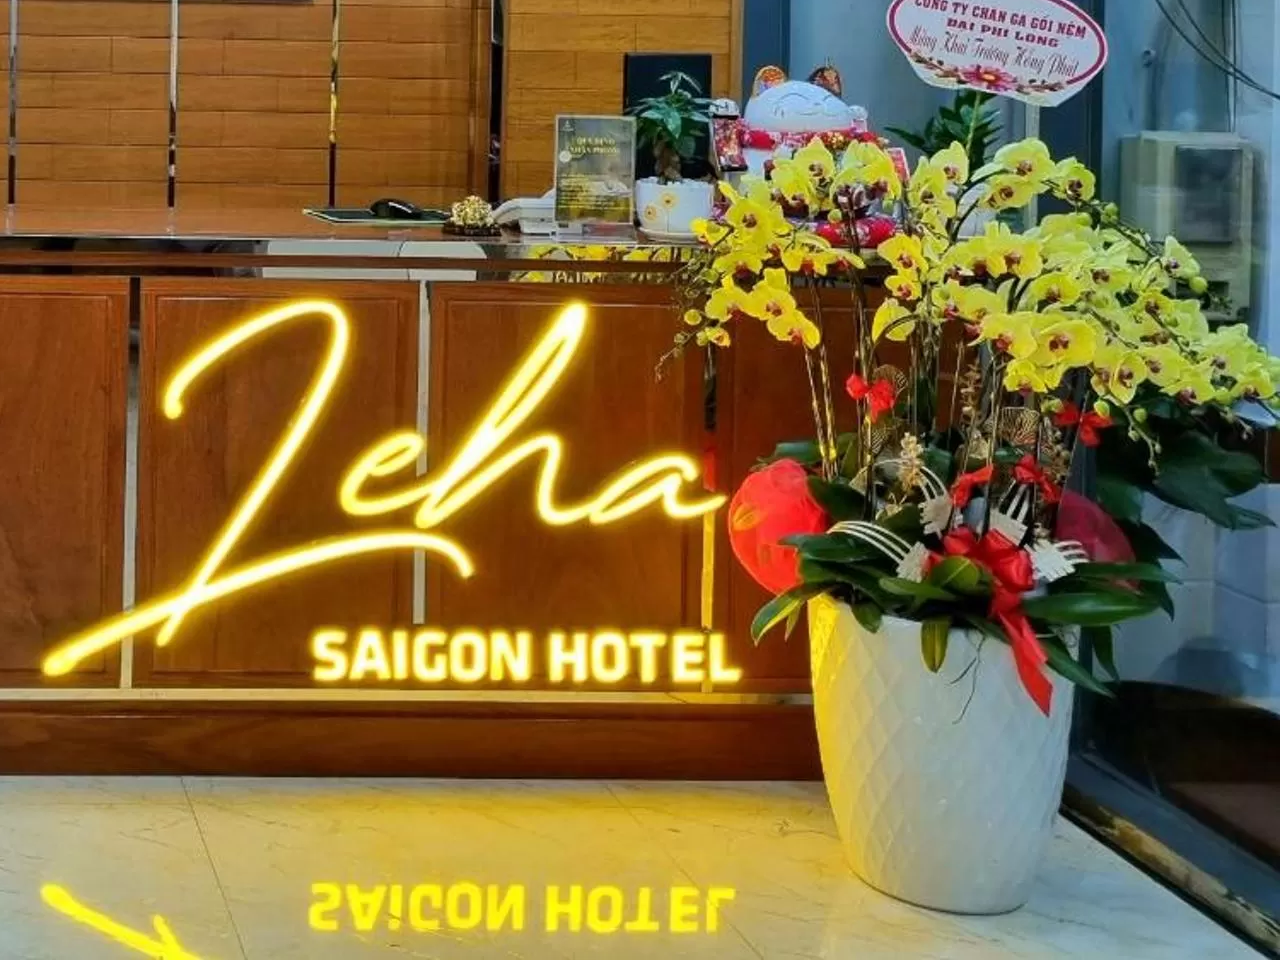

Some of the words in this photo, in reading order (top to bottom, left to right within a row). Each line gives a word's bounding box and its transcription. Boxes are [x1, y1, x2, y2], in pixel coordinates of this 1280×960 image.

[952, 1, 969, 15] TY
[1015, 30, 1059, 48] LONG
[310, 627, 532, 683] SAIGON
[546, 630, 744, 685] HOTEL
